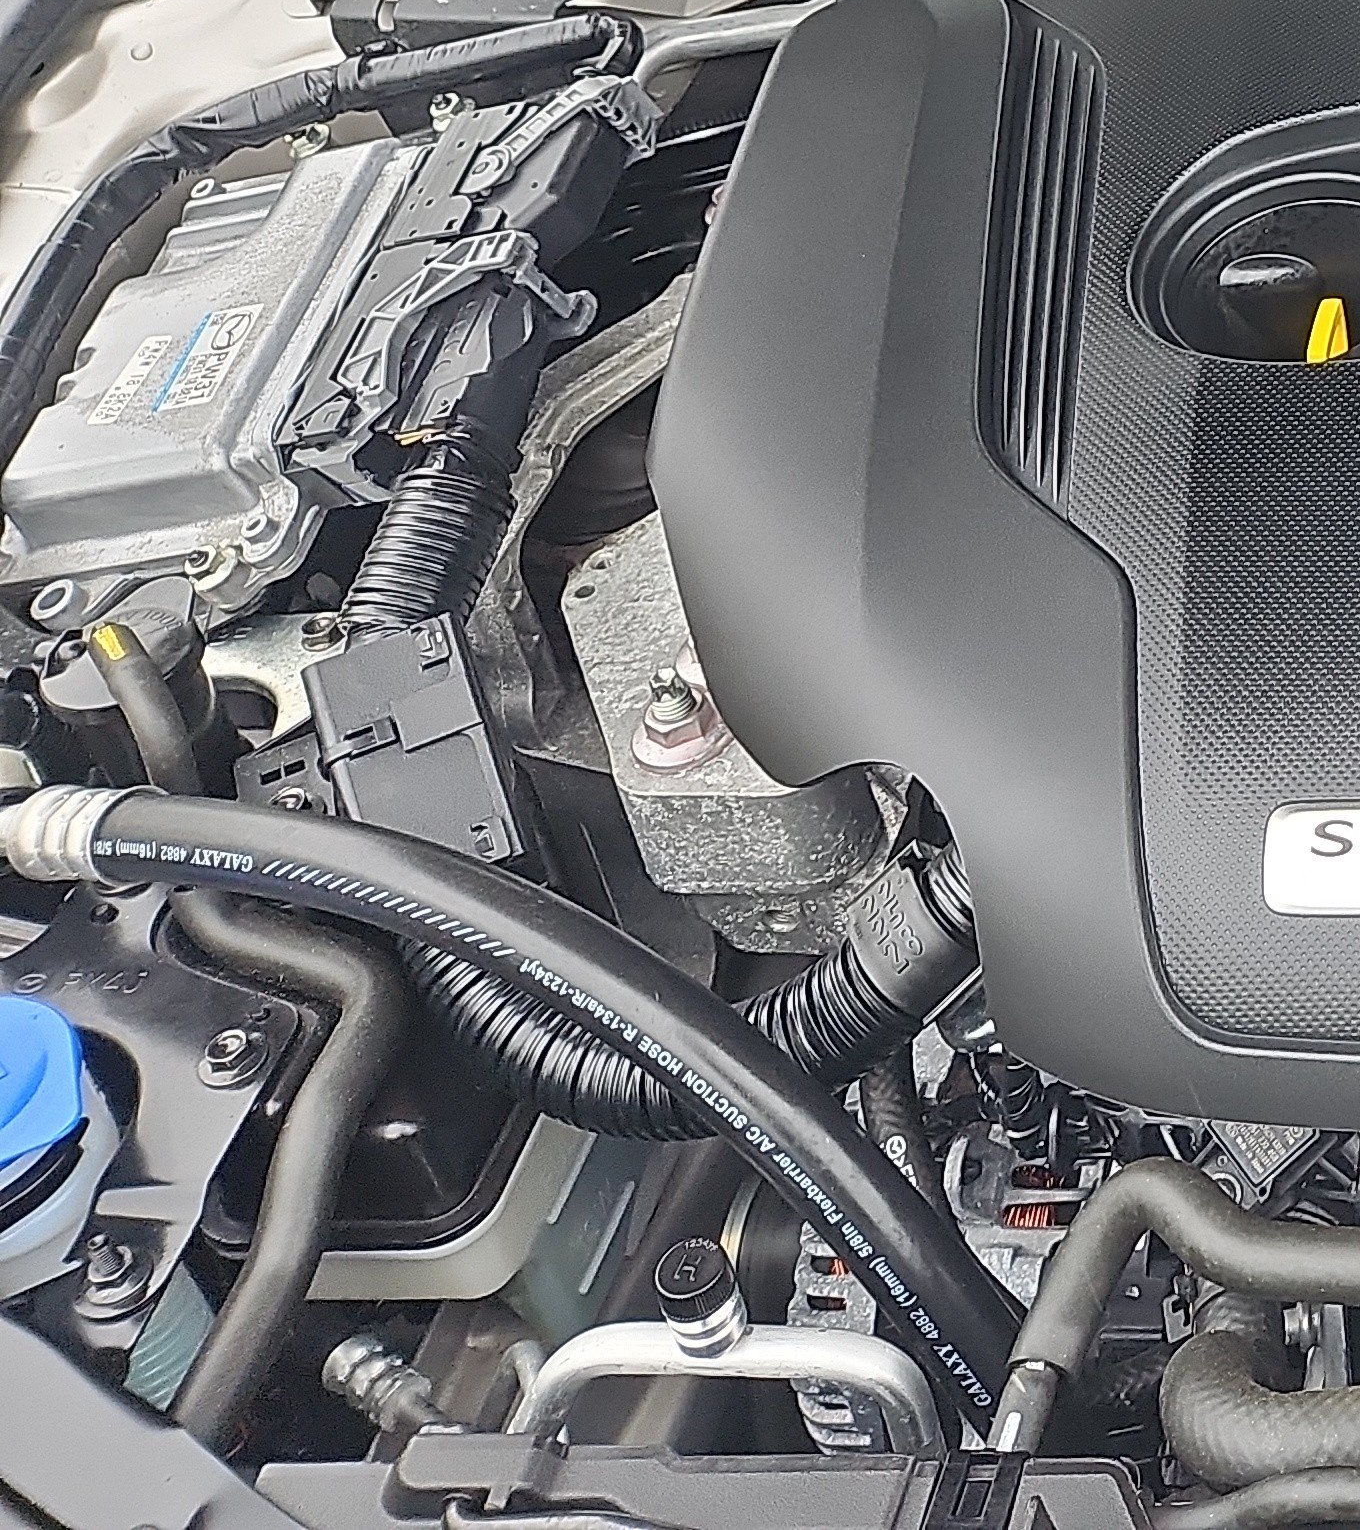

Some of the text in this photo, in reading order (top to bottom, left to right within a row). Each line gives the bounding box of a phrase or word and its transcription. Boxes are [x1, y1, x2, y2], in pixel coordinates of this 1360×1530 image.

[191, 847, 255, 873] GALAXY
[638, 1035, 688, 1076] HOSE
[682, 1070, 755, 1129] SUCTION
[746, 1127, 777, 1153] A/C
[774, 1154, 844, 1225] Flexbarrier
[869, 1258, 917, 1307] (16mm)
[910, 1309, 938, 1339] 4882
[934, 1345, 992, 1407] GALAXY
